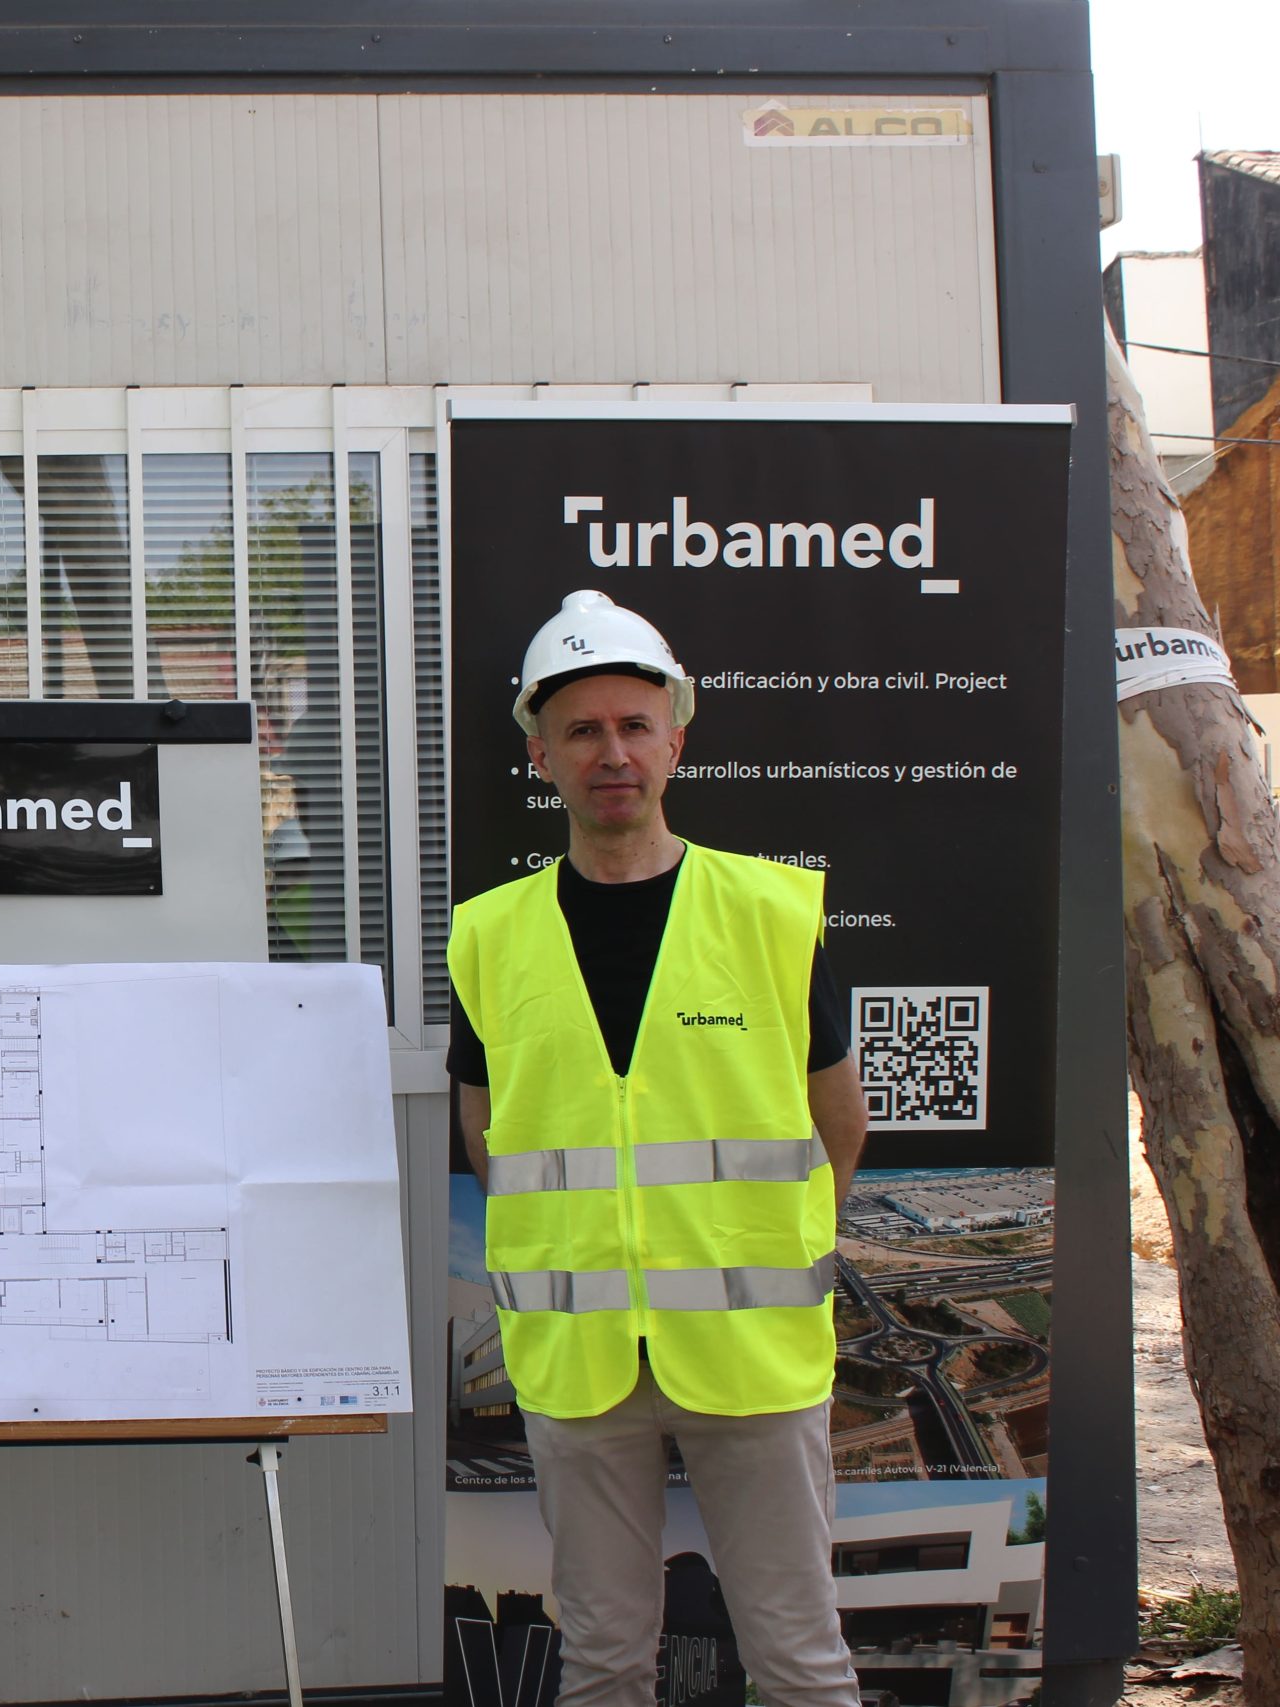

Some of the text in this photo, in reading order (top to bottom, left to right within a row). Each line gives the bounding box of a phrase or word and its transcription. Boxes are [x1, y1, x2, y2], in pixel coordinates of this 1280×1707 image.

[808, 117, 942, 136] ALCO
[589, 496, 934, 568] urbamed
[701, 672, 813, 690] edificación
[817, 675, 829, 692] y
[834, 672, 879, 690] obra
[885, 672, 929, 690] civil.
[935, 673, 1008, 693] Project
[667, 761, 1017, 782] sarrollos urbanísticos y gestión de
[681, 1012, 744, 1026] urbamed
[372, 1385, 400, 1397] 3.1.1
[925, 1464, 947, 1473] V-21
[949, 1463, 1001, 1474] (Valencia)
[455, 1475, 492, 1485] Centro
[494, 1475, 508, 1484] de
[510, 1475, 525, 1484] los
